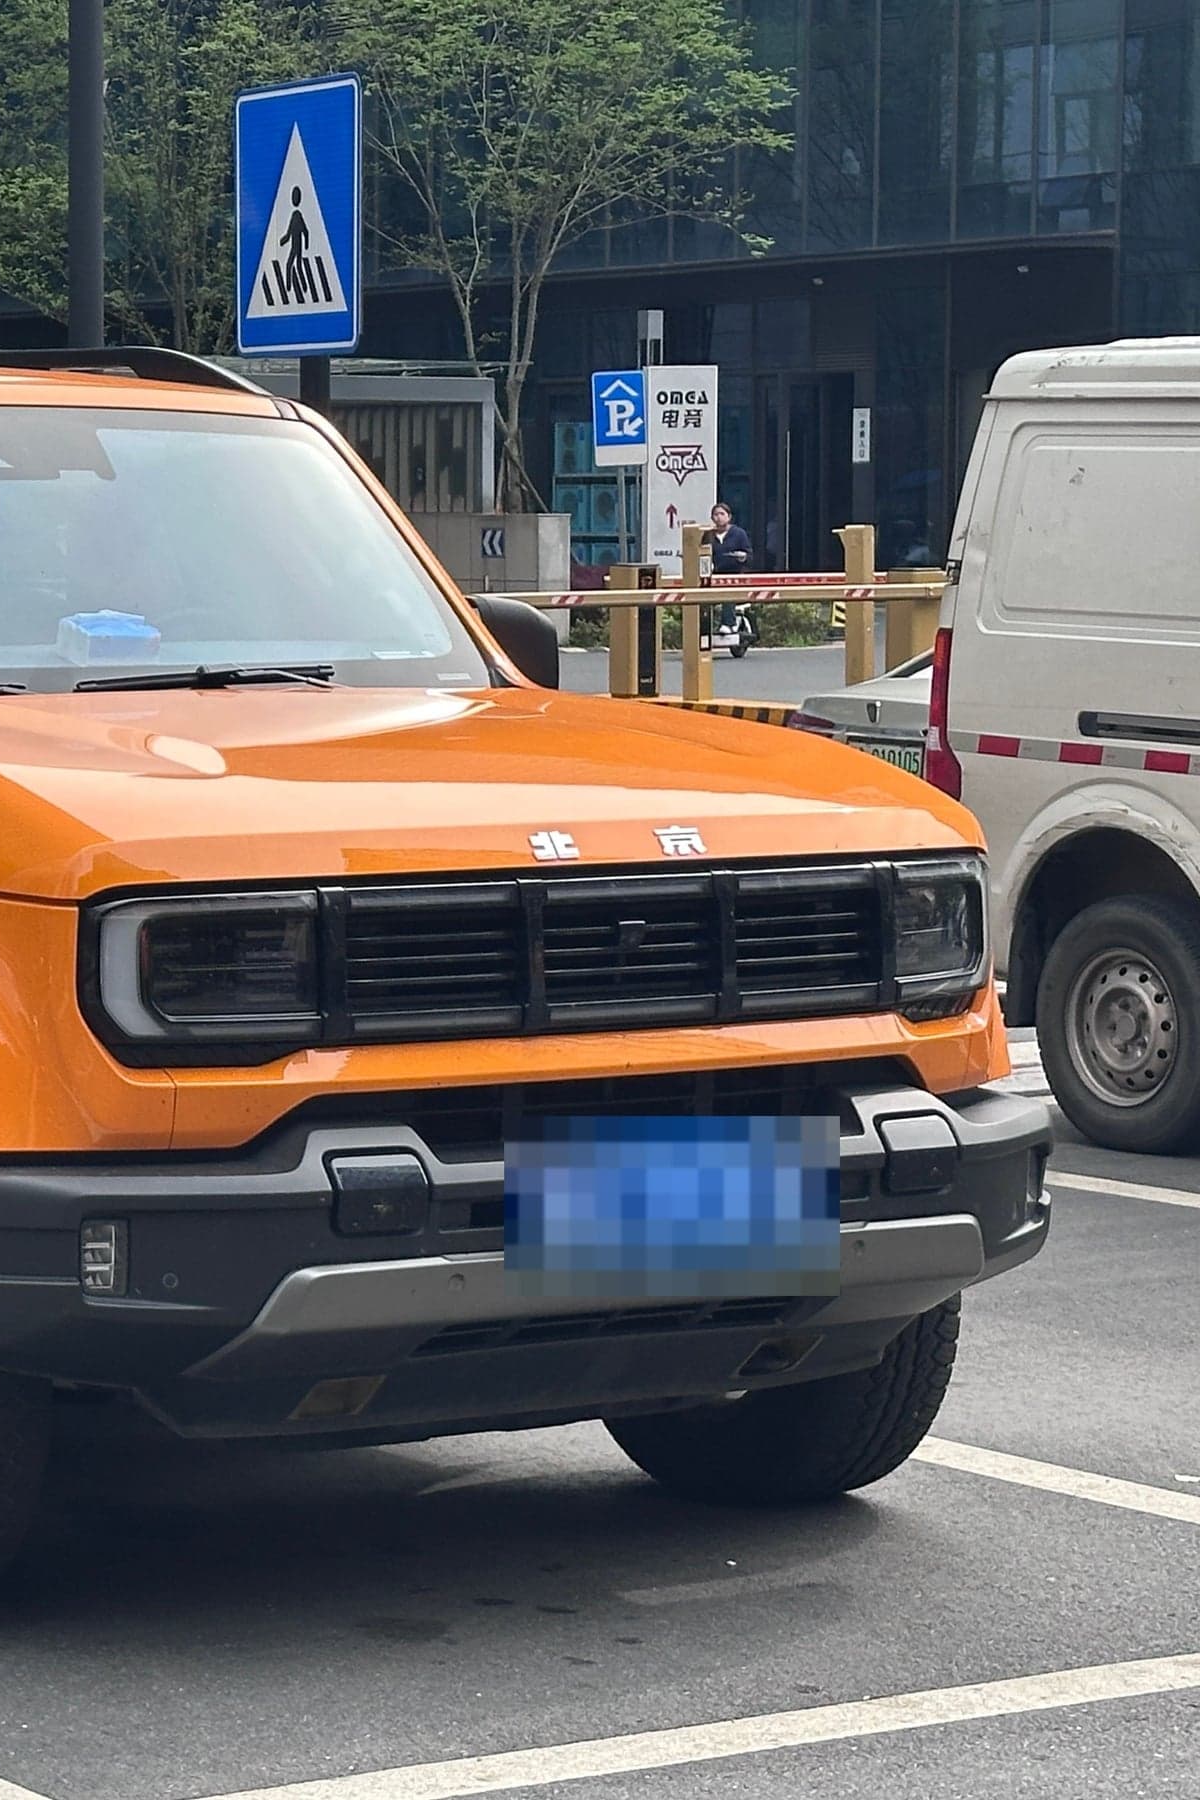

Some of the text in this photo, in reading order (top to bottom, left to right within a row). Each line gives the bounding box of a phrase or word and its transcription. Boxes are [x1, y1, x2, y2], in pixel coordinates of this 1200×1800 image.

[604, 400, 635, 437] P
[661, 408, 703, 429] 电竞
[527, 824, 709, 862] 北京
